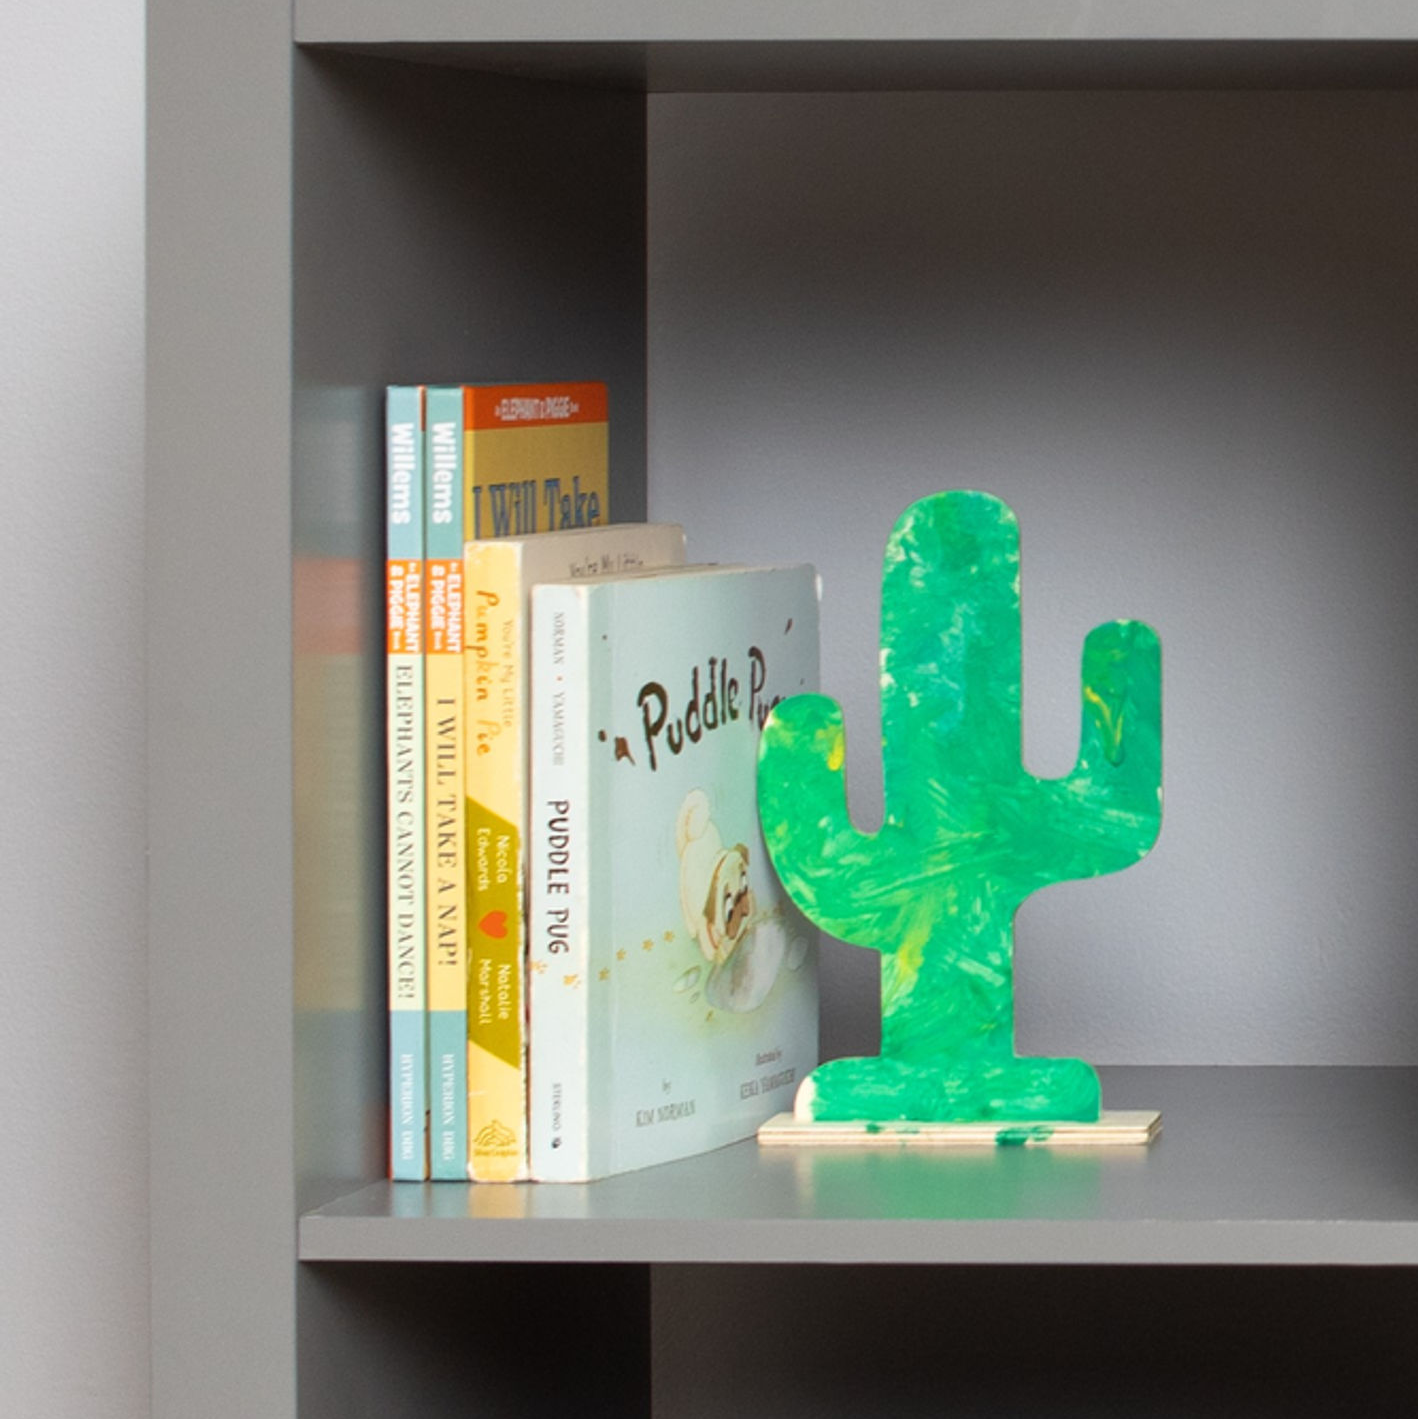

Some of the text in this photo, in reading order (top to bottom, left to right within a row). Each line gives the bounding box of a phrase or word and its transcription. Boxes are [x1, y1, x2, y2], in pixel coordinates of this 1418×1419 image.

[391, 423, 416, 524] Willems
[432, 423, 457, 524] Willems
[488, 479, 536, 539] Will
[543, 475, 600, 533] Take
[390, 579, 404, 630] PIGGIE
[406, 574, 420, 653] ELEPHANT
[431, 579, 445, 630] PIGGIE
[447, 574, 461, 653] ELEPHANT
[552, 612, 565, 664] NORMAN
[466, 590, 502, 757] Pumpkin Pie
[636, 645, 786, 772] Puddle Pu
[437, 716, 456, 785] WILL
[396, 665, 415, 998] ELEPHANTS CANNOT DANCE!
[437, 794, 457, 868] TAKE
[477, 828, 491, 891] Edwards
[496, 834, 512, 883] Nicola
[437, 878, 457, 893] A
[547, 800, 570, 954] PUDDLE PUG
[437, 905, 457, 966] NAP!
[478, 958, 493, 1025] Marshall
[497, 964, 512, 1020] Natalie
